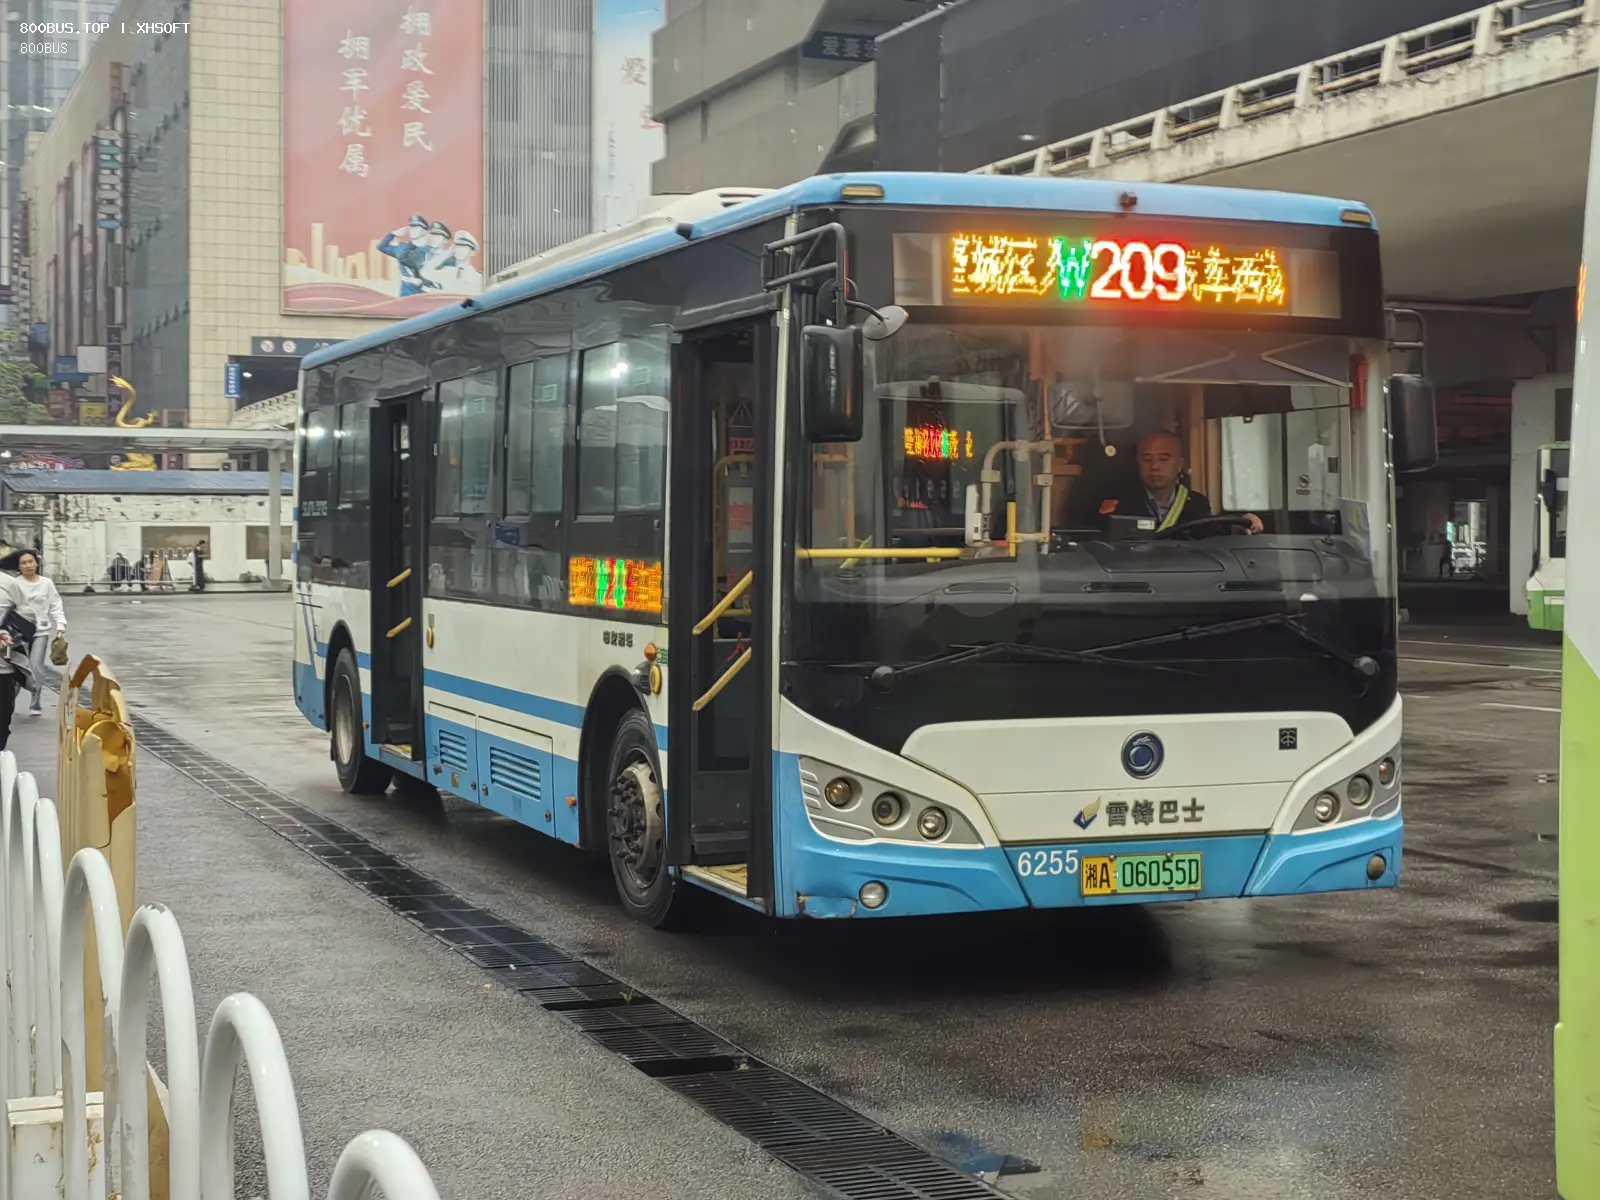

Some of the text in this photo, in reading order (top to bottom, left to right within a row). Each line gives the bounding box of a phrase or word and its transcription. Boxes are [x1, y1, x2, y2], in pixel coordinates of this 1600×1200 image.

[1105, 797, 1205, 827] 雷锋巴士
[1017, 849, 1079, 876] 6255
[1084, 858, 1200, 889] 湘A 06055D
